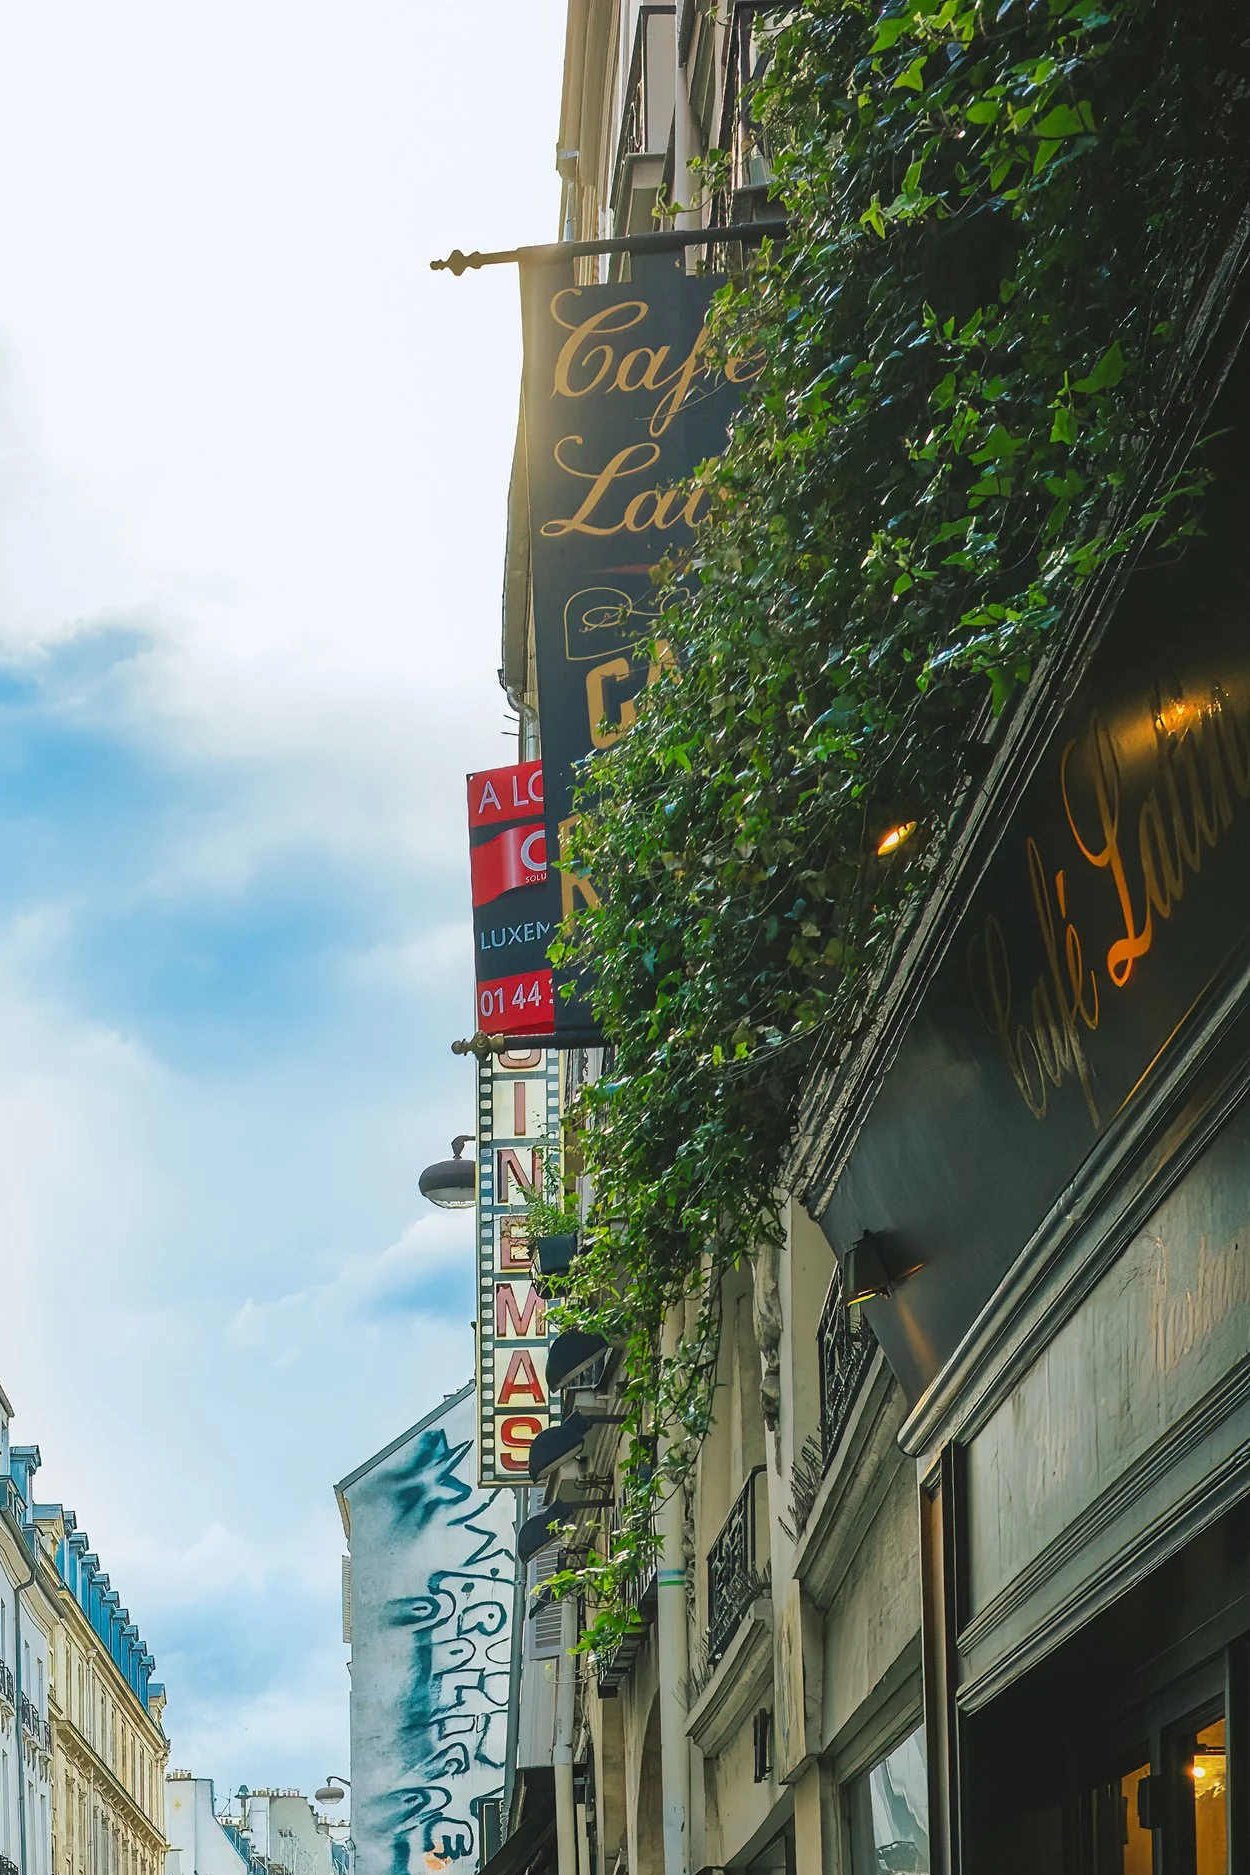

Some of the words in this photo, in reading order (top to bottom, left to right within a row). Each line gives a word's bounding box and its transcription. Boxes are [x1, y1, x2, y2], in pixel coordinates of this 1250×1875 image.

[478, 780, 502, 814] A
[480, 987, 504, 1017] 01
[511, 980, 542, 1010] 44
